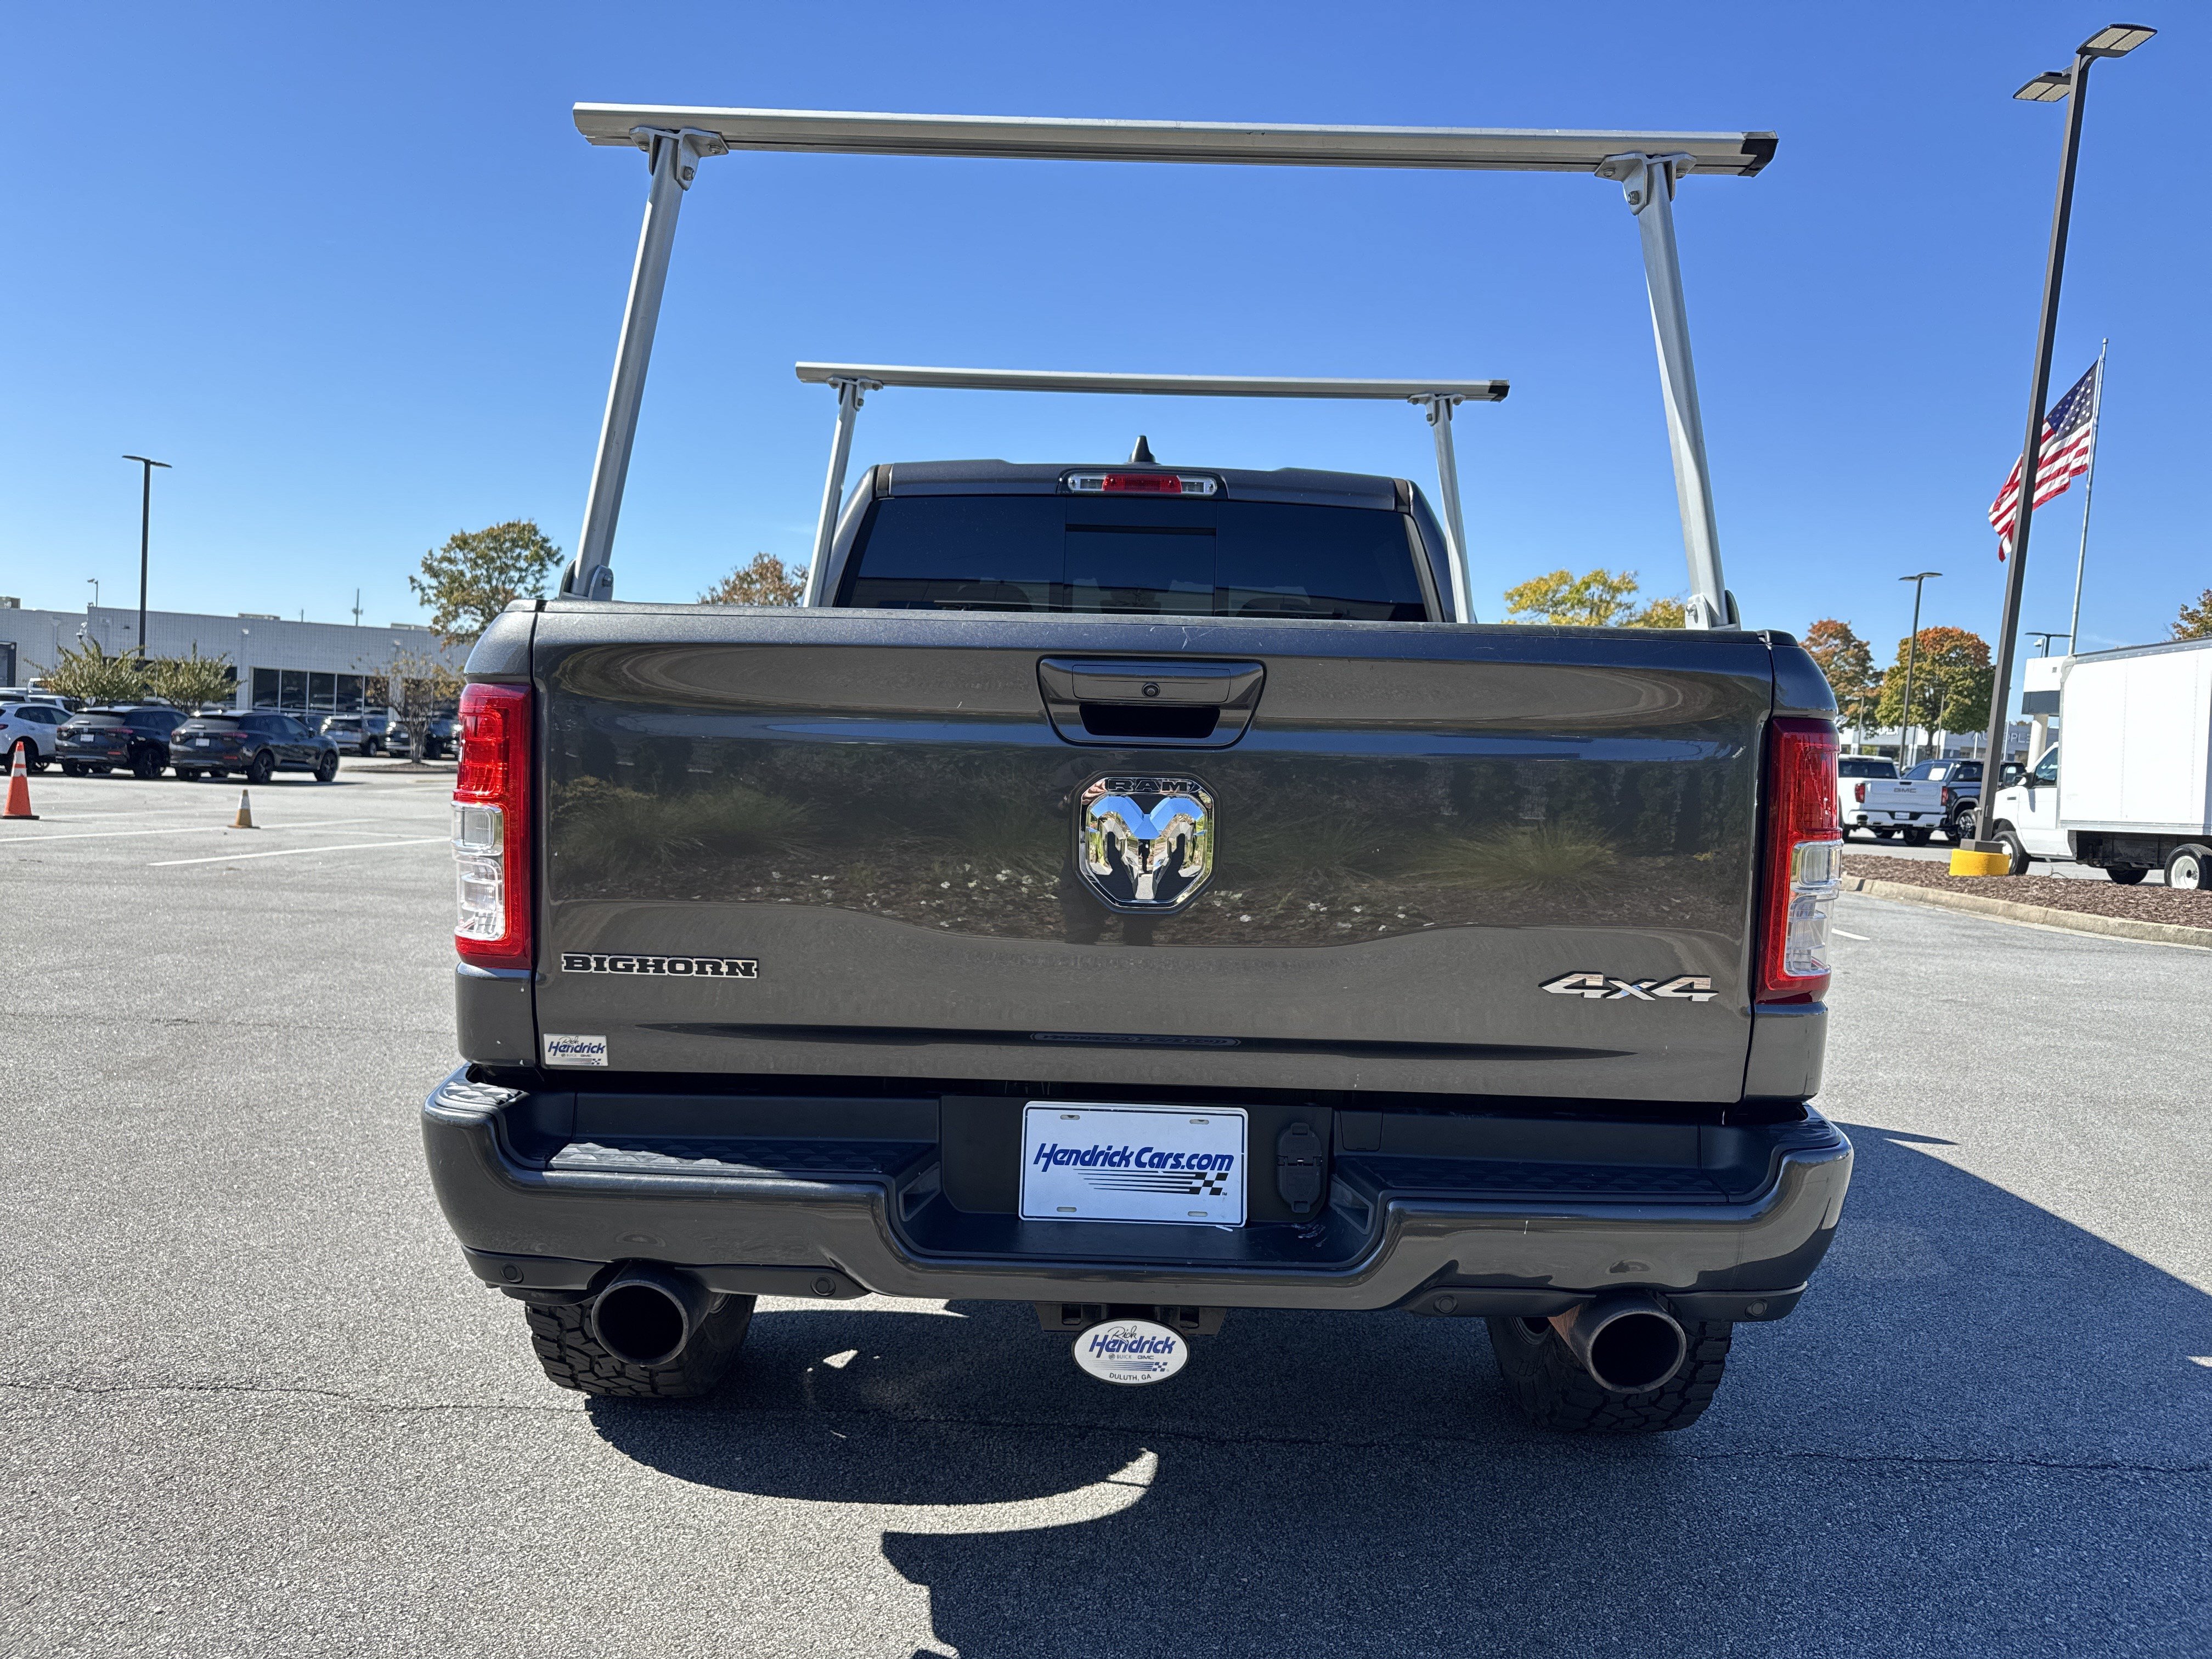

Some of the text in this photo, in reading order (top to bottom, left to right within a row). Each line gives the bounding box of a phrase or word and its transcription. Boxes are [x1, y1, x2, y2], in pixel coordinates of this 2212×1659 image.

[1107, 779, 1188, 792] RAM
[561, 952, 759, 979] BIGHORN
[548, 1041, 606, 1057] Hendrick
[559, 1036, 579, 1046] Rick
[1033, 1143, 1234, 1172] HendrickCars.com
[1107, 1325, 1138, 1342] Rick
[1088, 1334, 1176, 1358] Hendrick
[1109, 1373, 1139, 1381] DULUTH,
